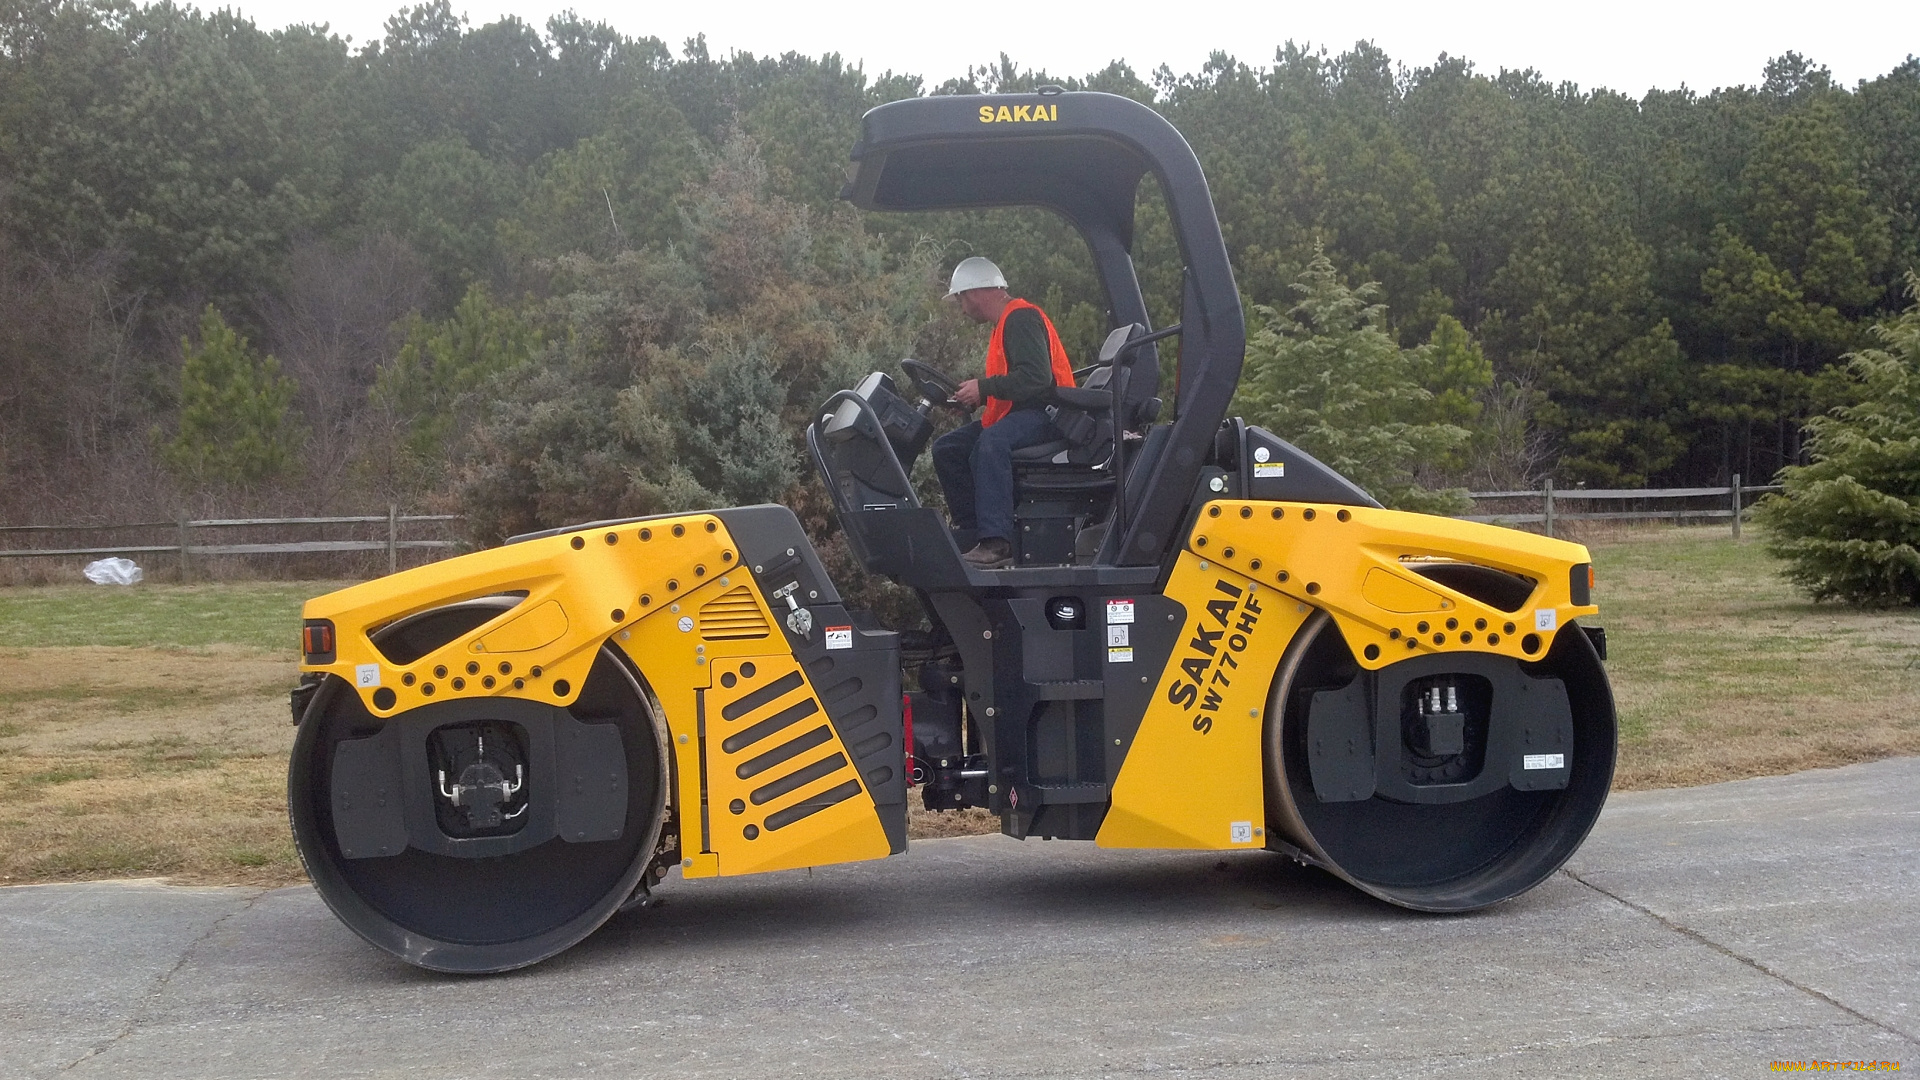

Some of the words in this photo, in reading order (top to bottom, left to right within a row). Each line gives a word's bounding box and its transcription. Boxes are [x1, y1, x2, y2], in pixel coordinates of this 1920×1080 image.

[979, 105, 1057, 123] SAKAI
[1168, 579, 1243, 711] SAKAI
[1193, 593, 1262, 735] SW770HF
